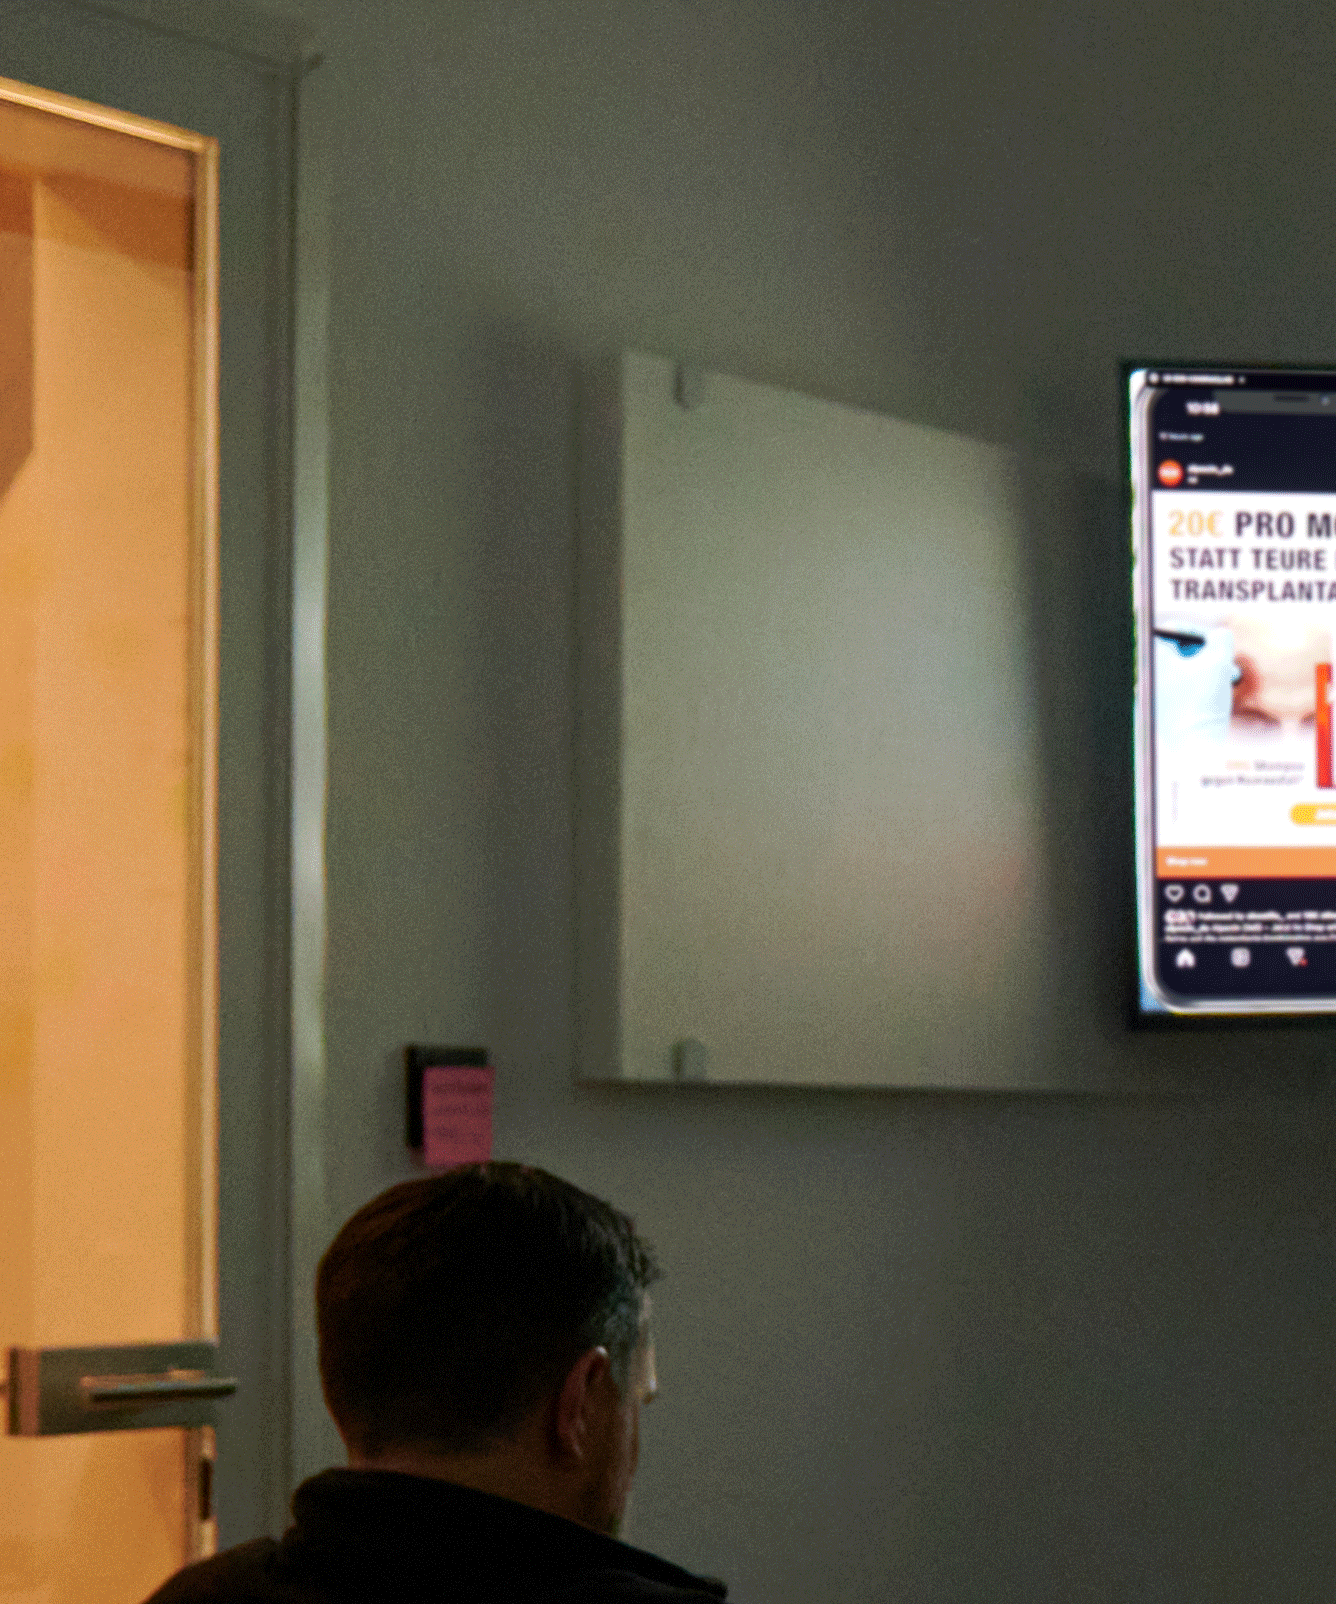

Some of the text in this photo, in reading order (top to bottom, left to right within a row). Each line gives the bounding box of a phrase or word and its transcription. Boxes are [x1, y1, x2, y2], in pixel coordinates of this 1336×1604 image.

[1168, 509, 1223, 538] 20€
[1234, 511, 1295, 538] PRO
[1169, 547, 1241, 569] STATT
[1251, 549, 1326, 572] TEURE
